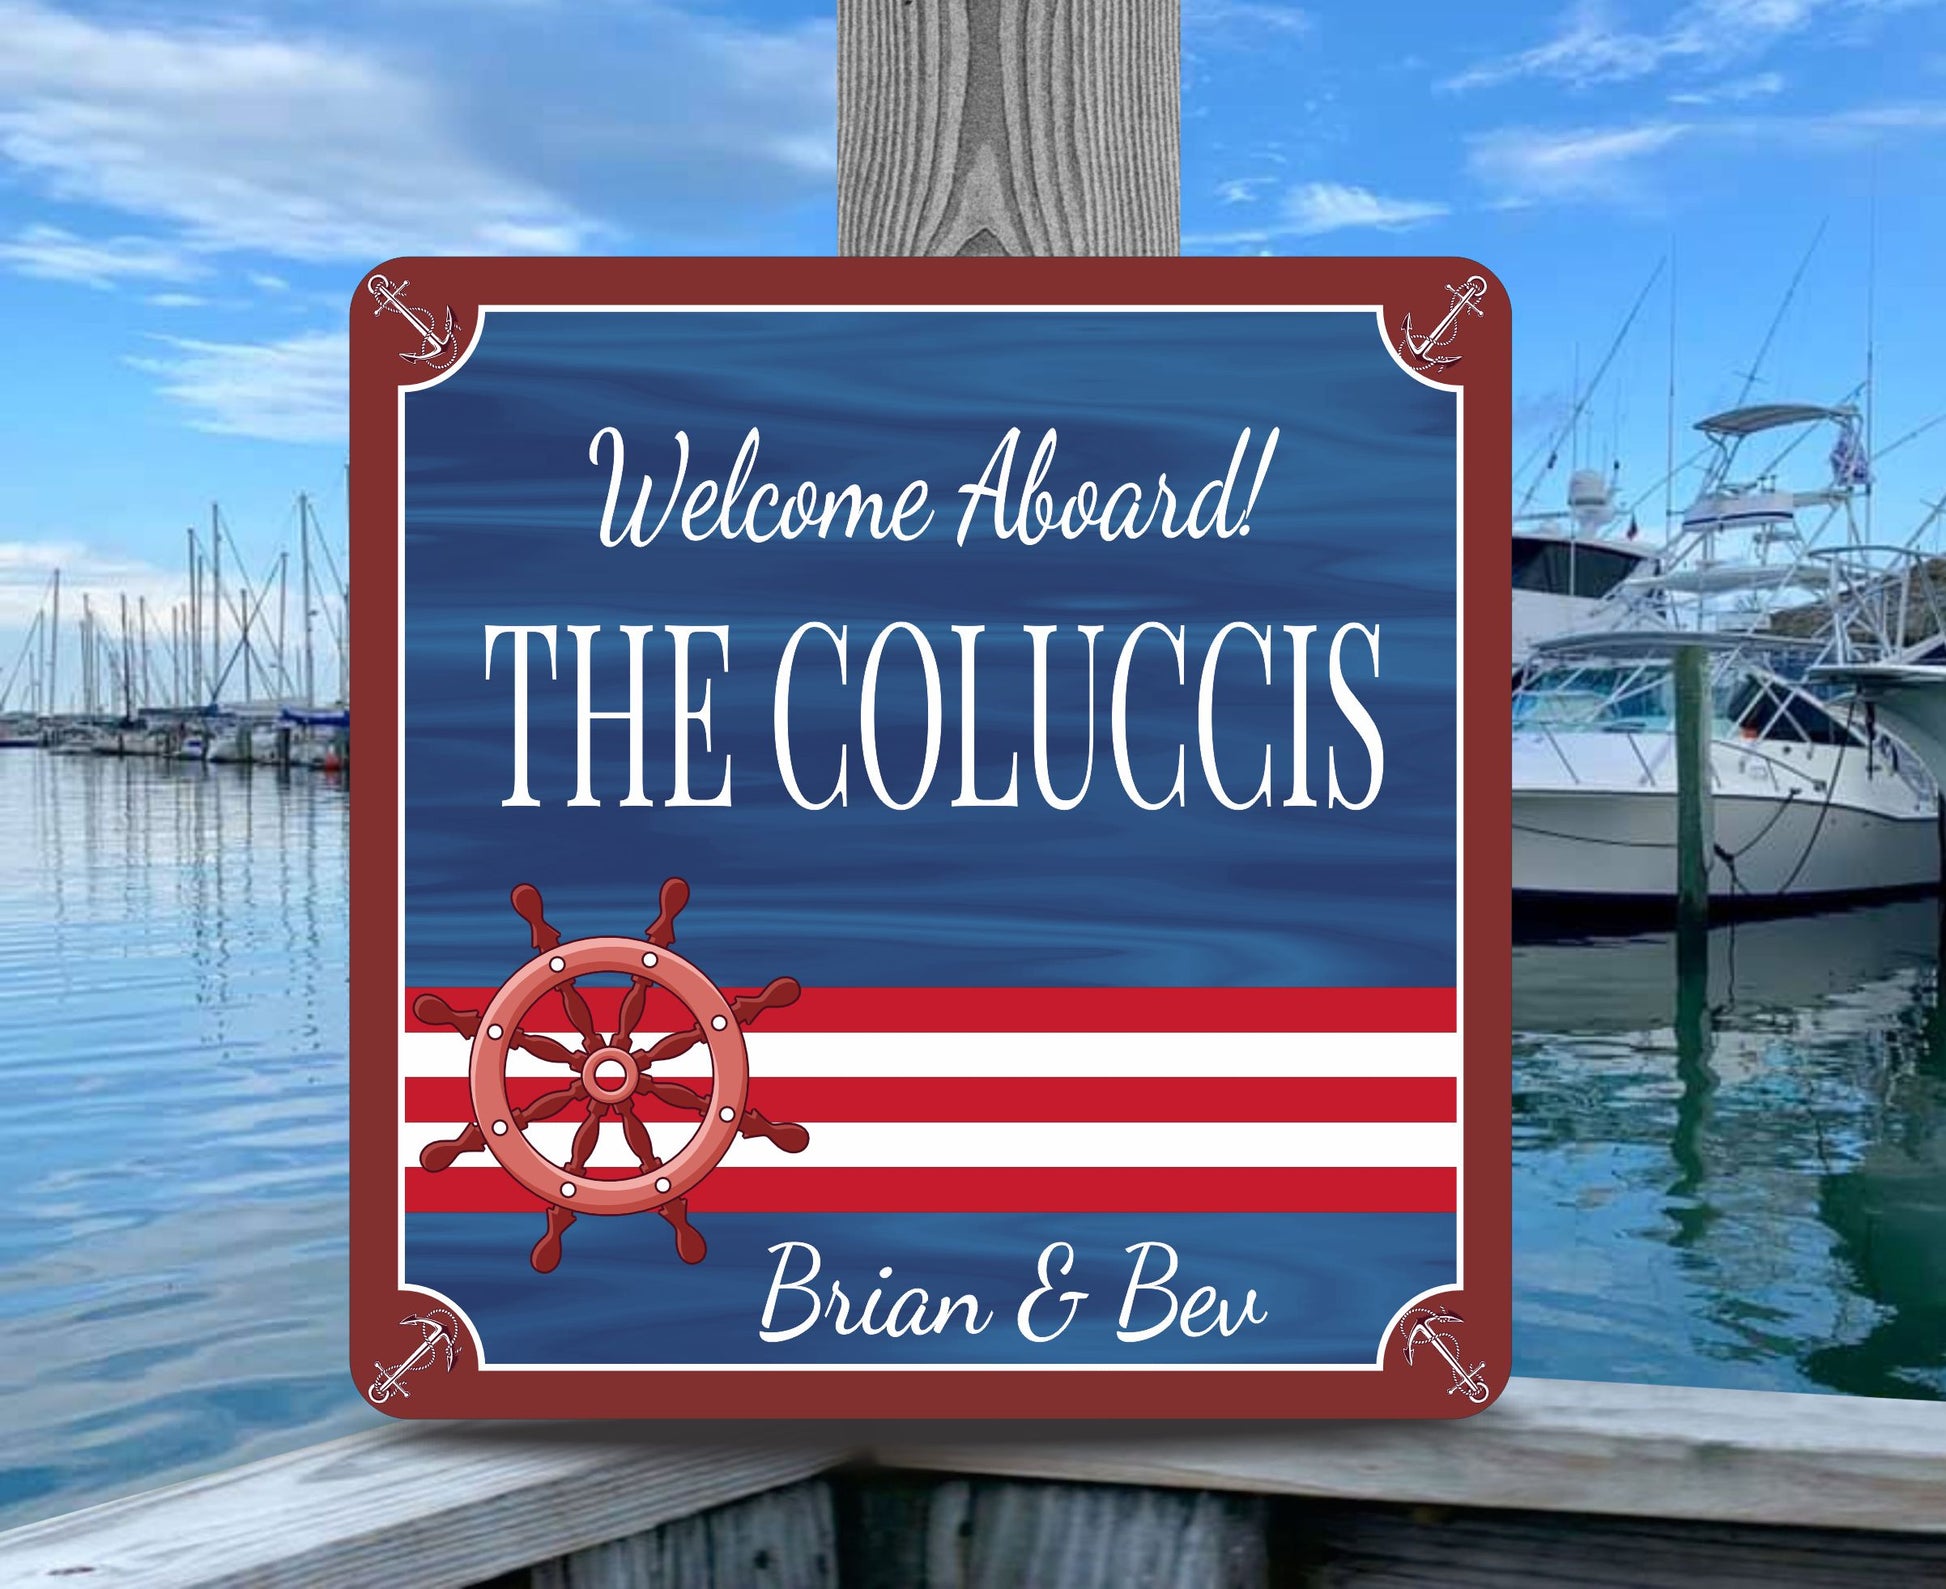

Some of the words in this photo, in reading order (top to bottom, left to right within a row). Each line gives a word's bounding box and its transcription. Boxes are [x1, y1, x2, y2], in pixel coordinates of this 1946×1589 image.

[588, 426, 935, 548] Welcome
[956, 426, 1280, 548] Aboard!
[484, 624, 732, 807] THE
[773, 621, 1384, 811] COLUCCIS
[759, 1241, 994, 1343] Brian
[1017, 1241, 1090, 1343] &
[1116, 1241, 1268, 1343] Bev
